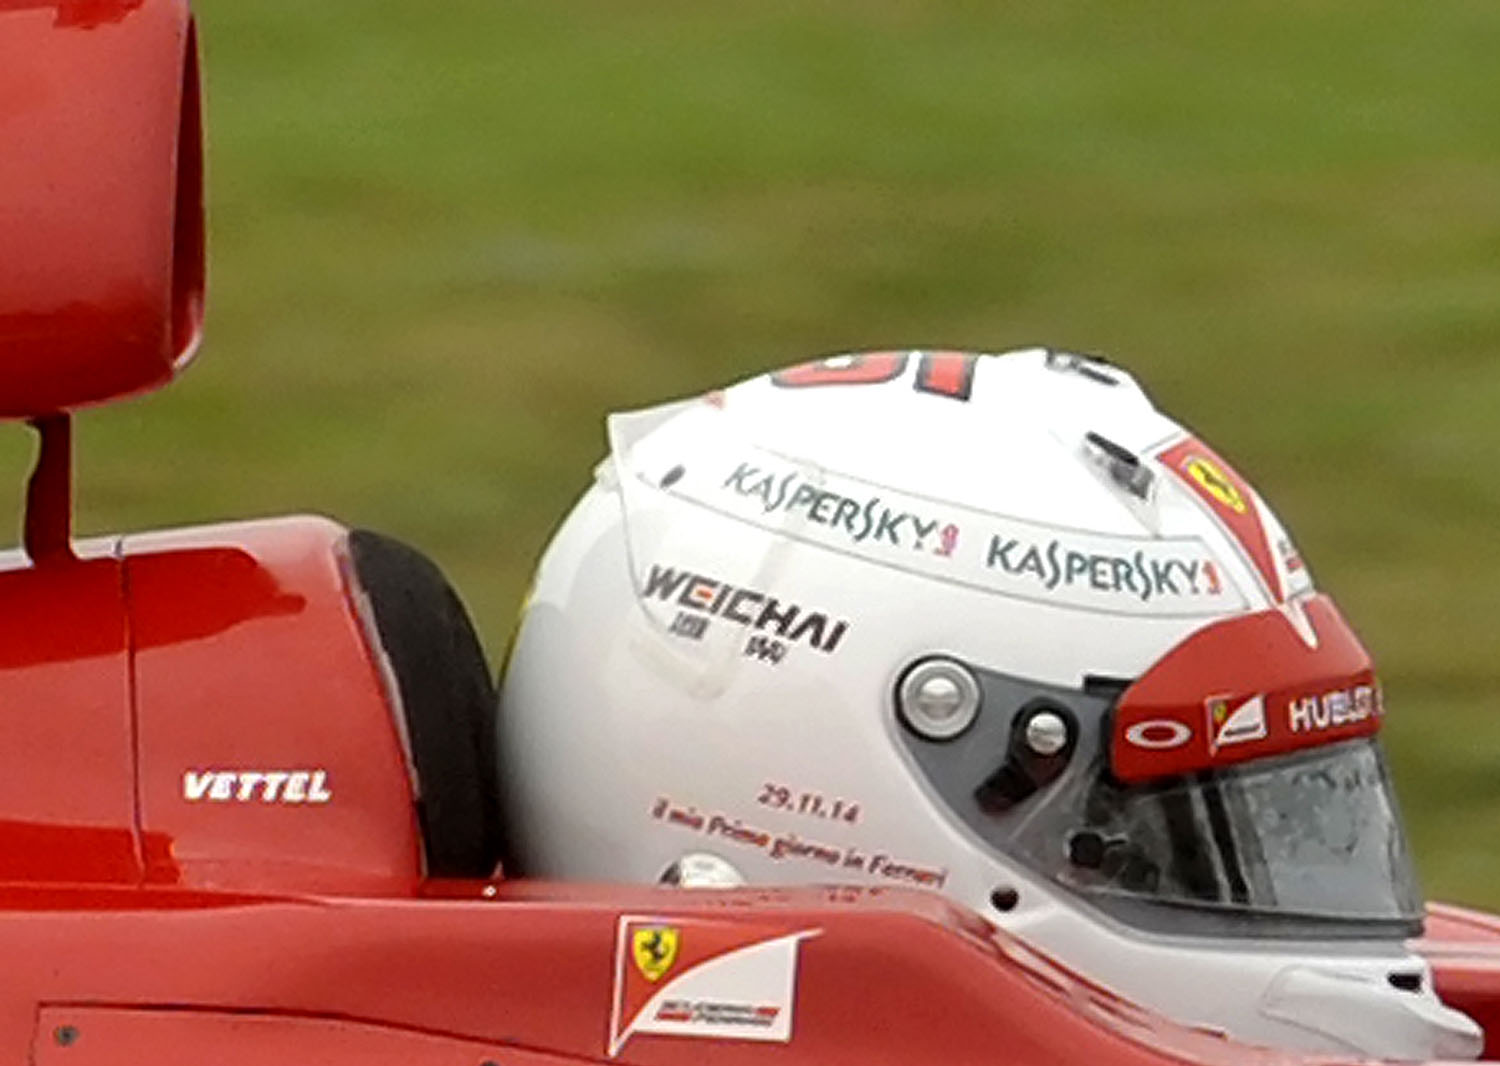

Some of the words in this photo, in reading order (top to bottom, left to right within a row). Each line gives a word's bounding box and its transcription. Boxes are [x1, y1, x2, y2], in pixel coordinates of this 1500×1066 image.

[723, 463, 938, 549] KASPERSKY
[986, 534, 1199, 601] KASPERSKY
[643, 564, 849, 653] WEICHAI
[184, 770, 332, 802] VETTEL
[757, 783, 860, 823] 29.11.14
